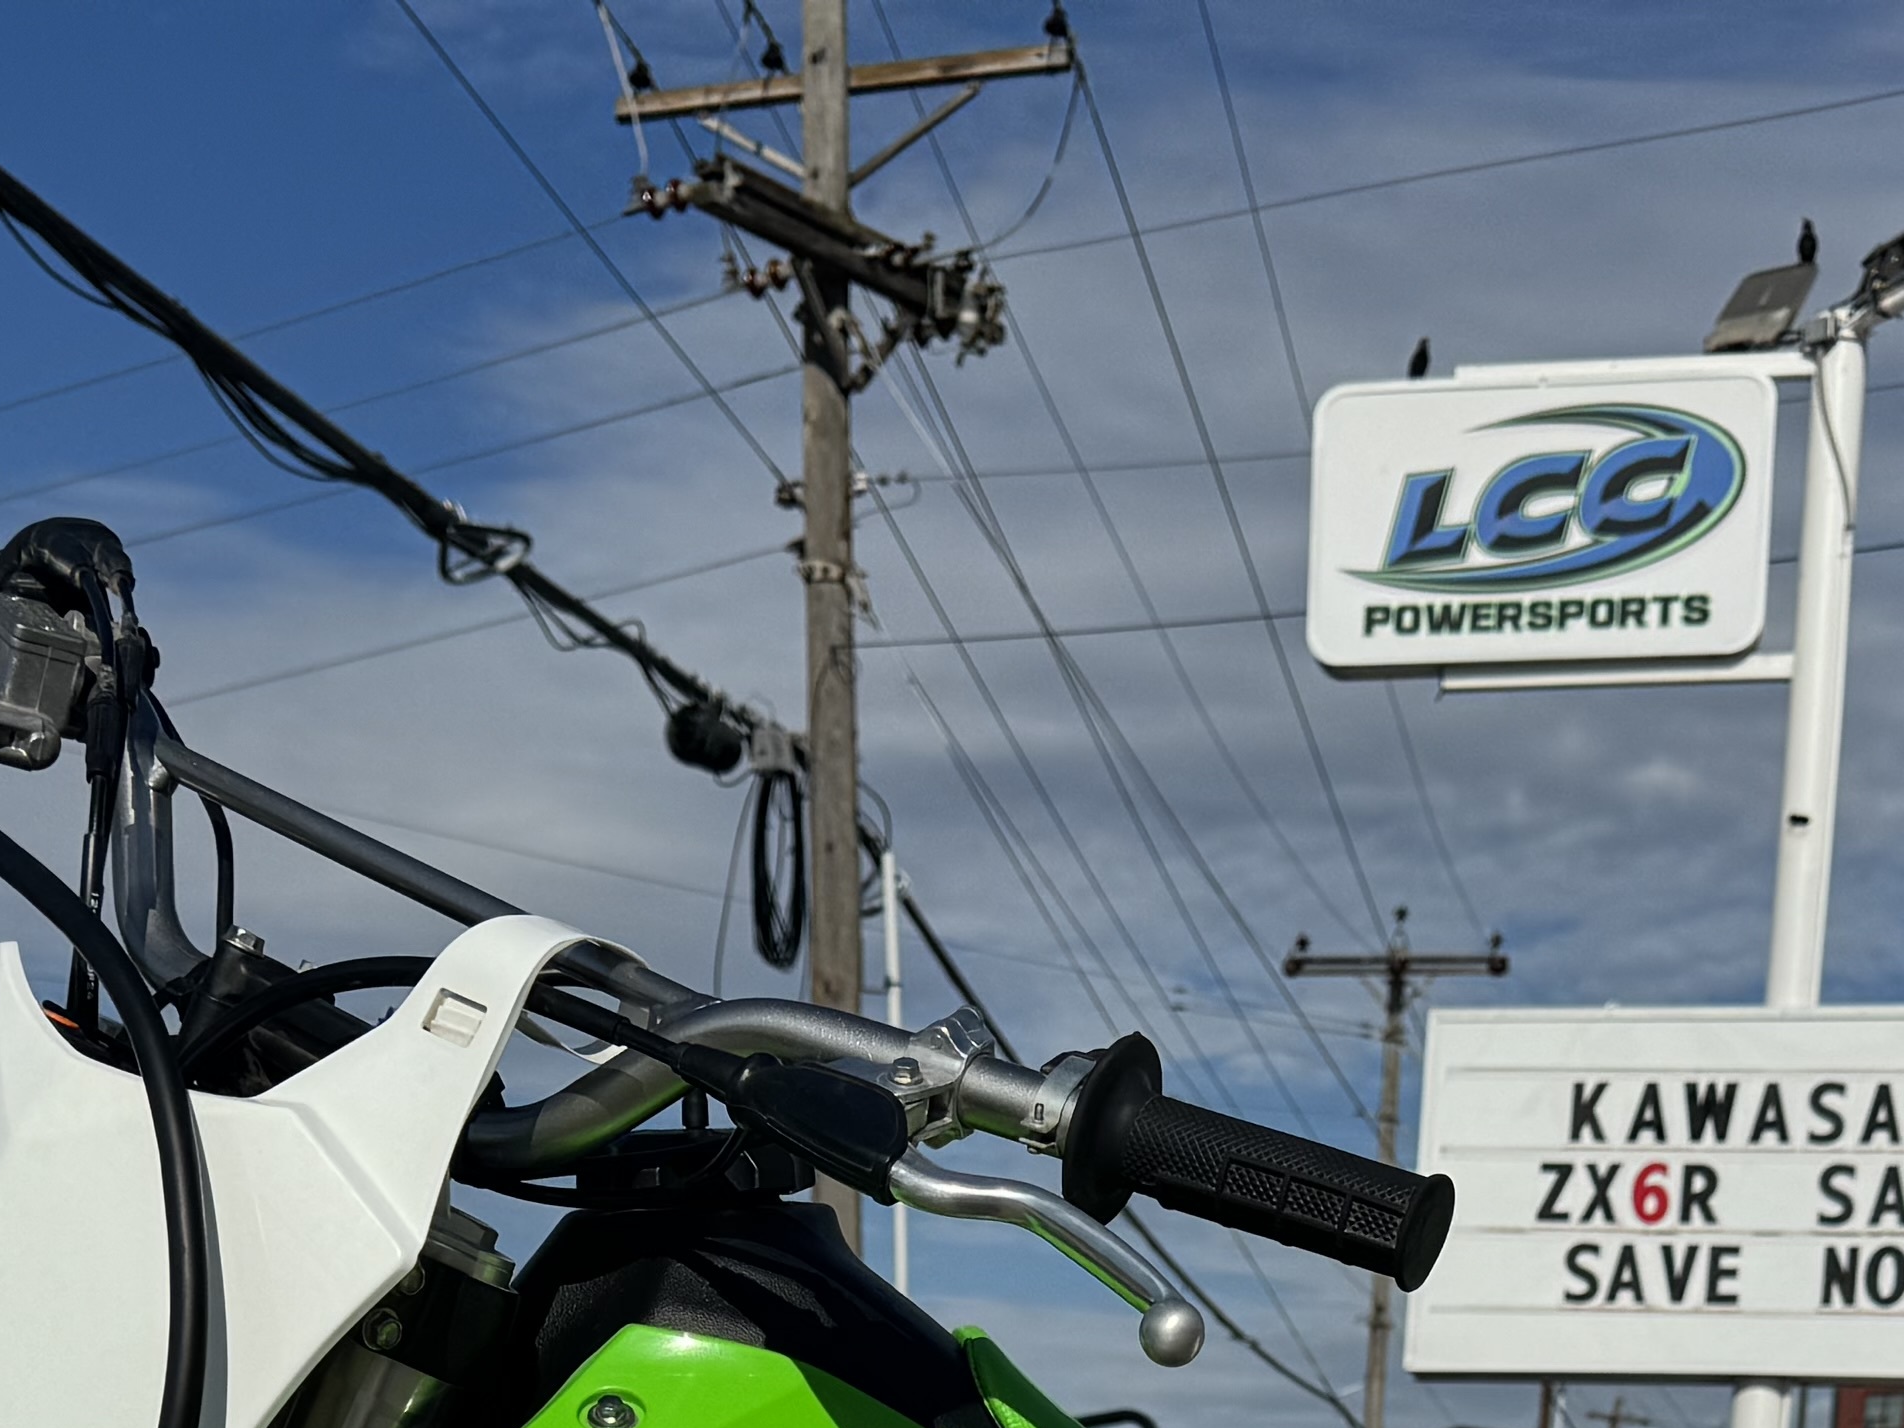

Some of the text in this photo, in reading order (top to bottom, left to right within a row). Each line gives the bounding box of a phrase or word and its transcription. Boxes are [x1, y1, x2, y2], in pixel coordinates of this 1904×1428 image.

[1378, 432, 1698, 571] LCC
[1361, 594, 1712, 639] POWERSPORTS
[1535, 1161, 1720, 1227] ZX6R
[1563, 1243, 1742, 1307] SAVE
